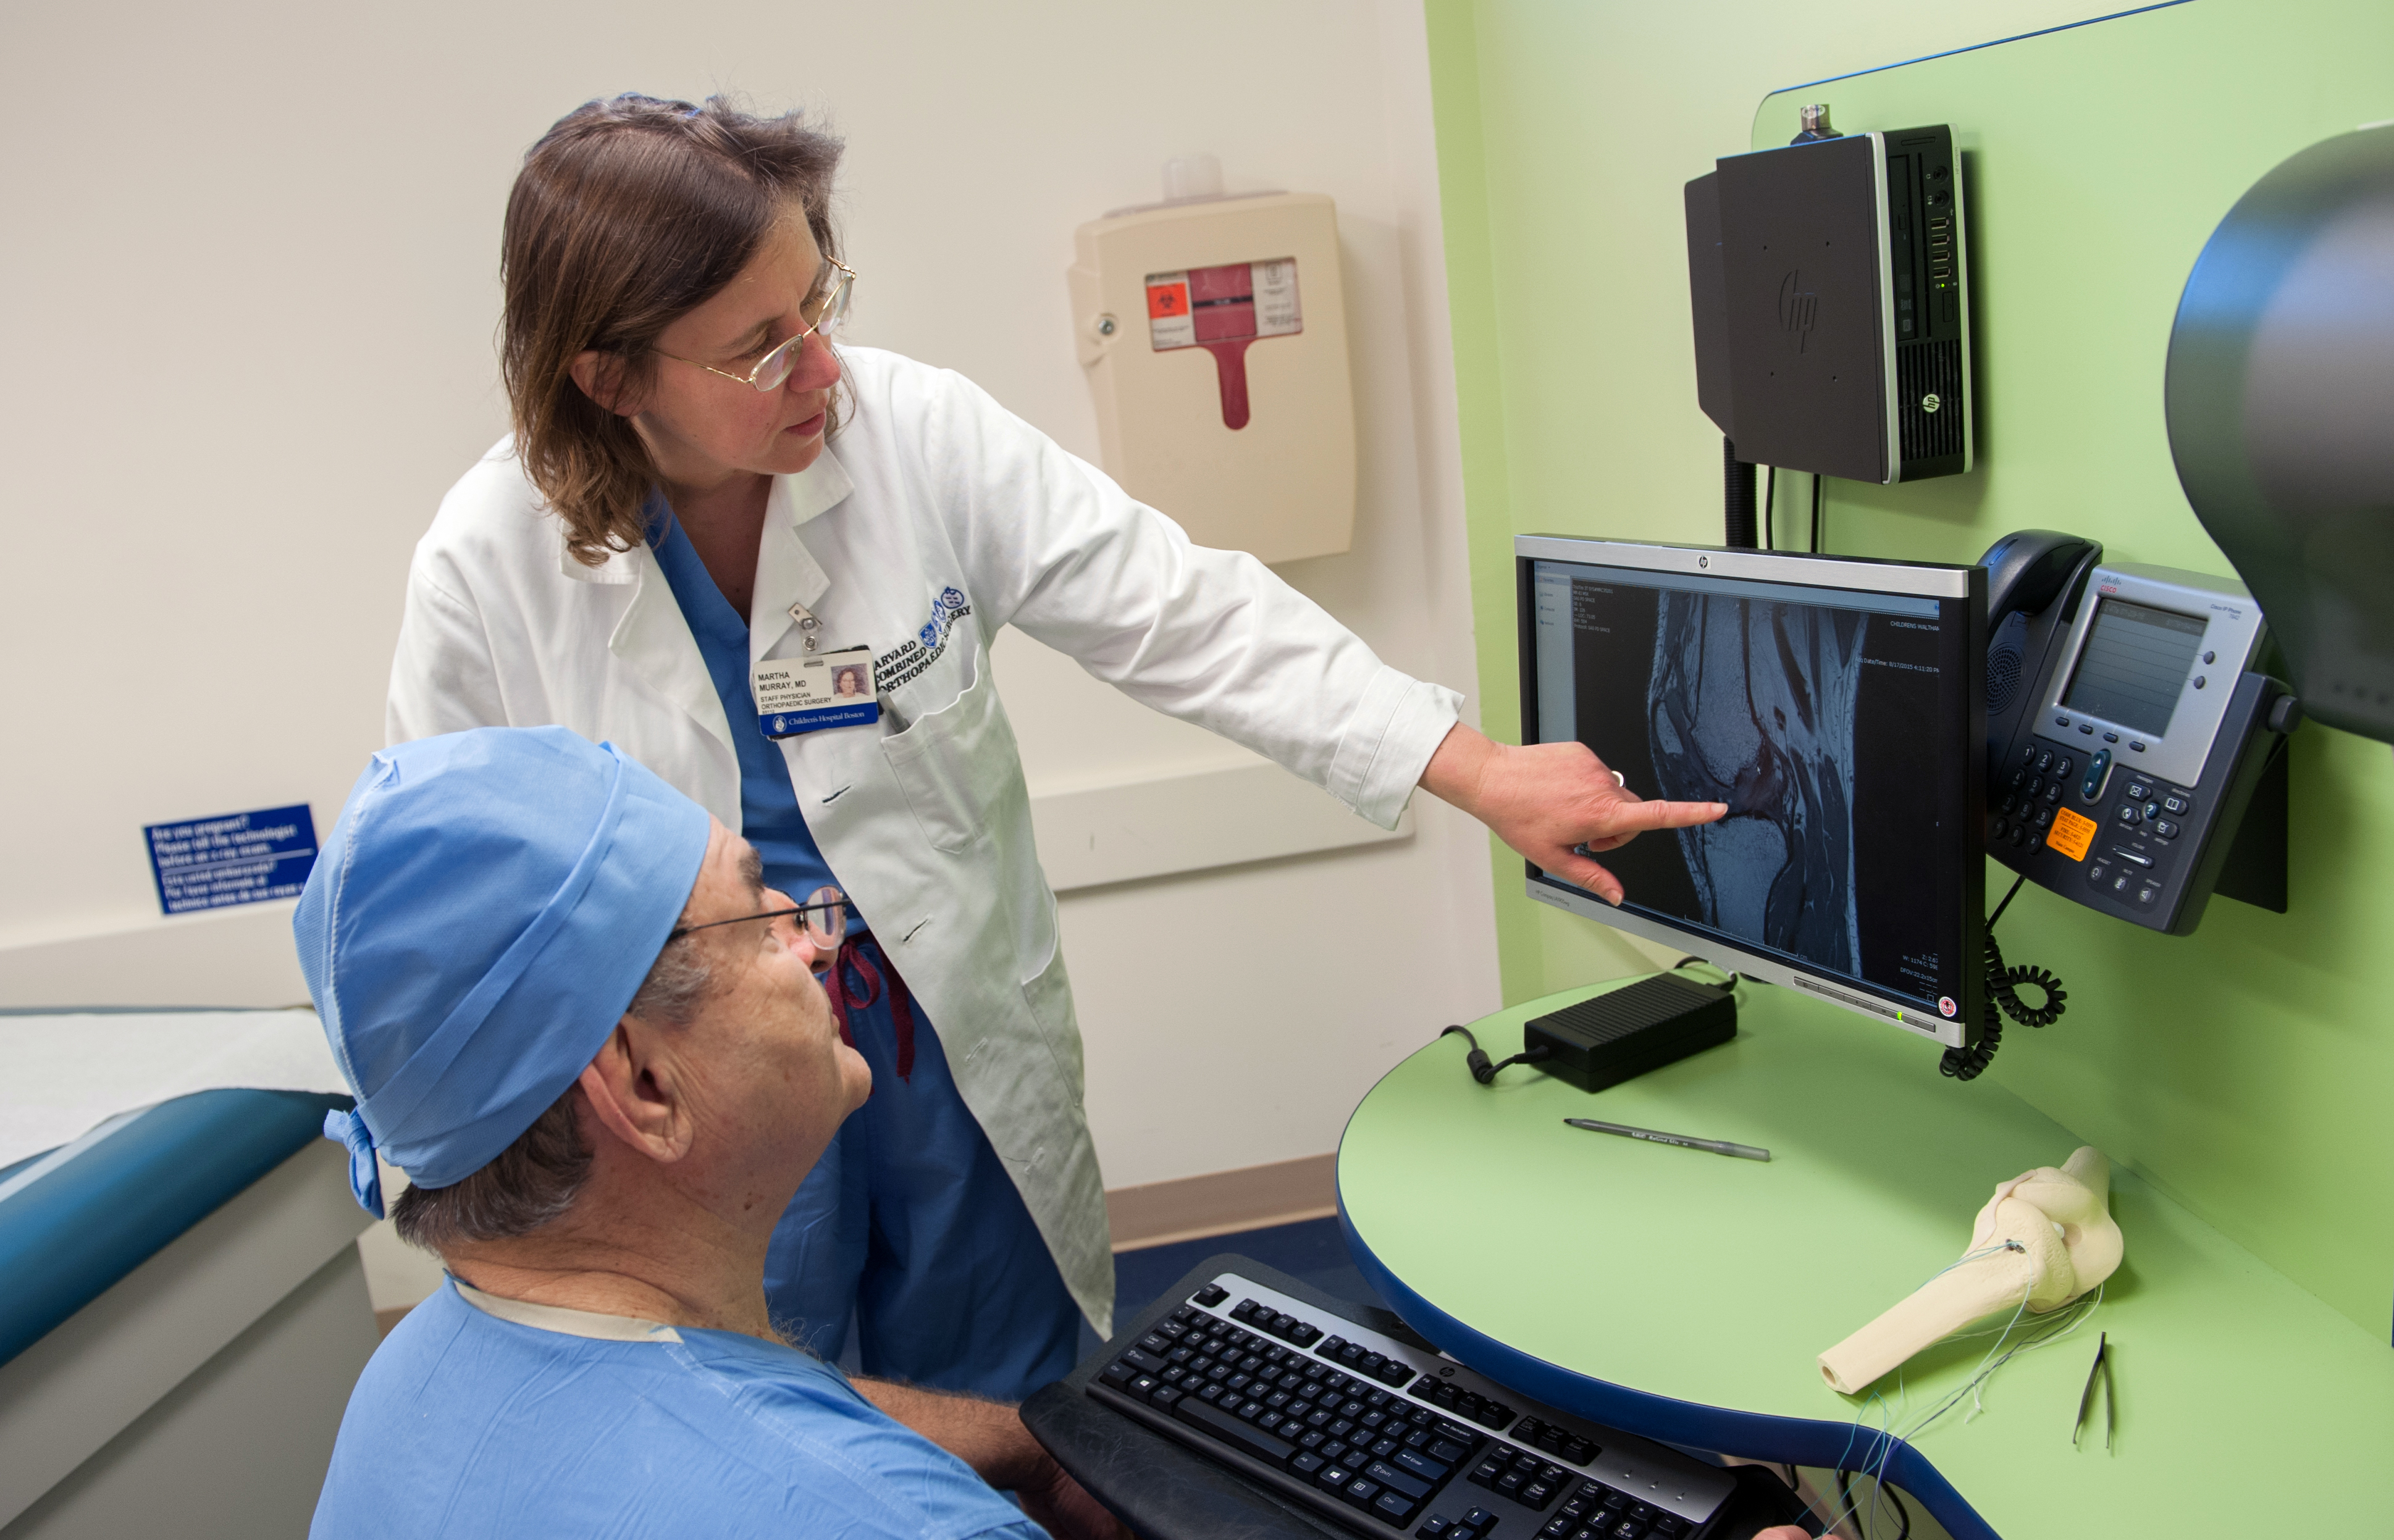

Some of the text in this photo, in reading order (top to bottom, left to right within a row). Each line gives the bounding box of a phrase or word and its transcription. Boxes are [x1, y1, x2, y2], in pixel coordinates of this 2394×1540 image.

[1922, 395, 1940, 410] hp
[1699, 555, 1708, 569] hp
[943, 605, 971, 641] SURGERY
[1890, 621, 1917, 629] CHILDRENS
[875, 640, 917, 671] ARVARD
[1889, 661, 1913, 670] 8/17/2015
[758, 672, 790, 681] MARTHA
[760, 682, 794, 691] MURRAY,
[762, 697, 831, 709] ORTHOPAEDIC SURGERY
[789, 717, 818, 726] Children's
[819, 713, 843, 722] Hospital
[2042, 755, 2048, 763] 2
[2041, 812, 2046, 820] 9
[1498, 1446, 1512, 1455] Insert
[1410, 1458, 1423, 1466] Enter
[1482, 1463, 1496, 1472] Delete
[1550, 1466, 1563, 1474] Page
[1379, 1468, 1392, 1477] Shift
[1533, 1484, 1545, 1492] Page
[1564, 1506, 1579, 1514] Home
